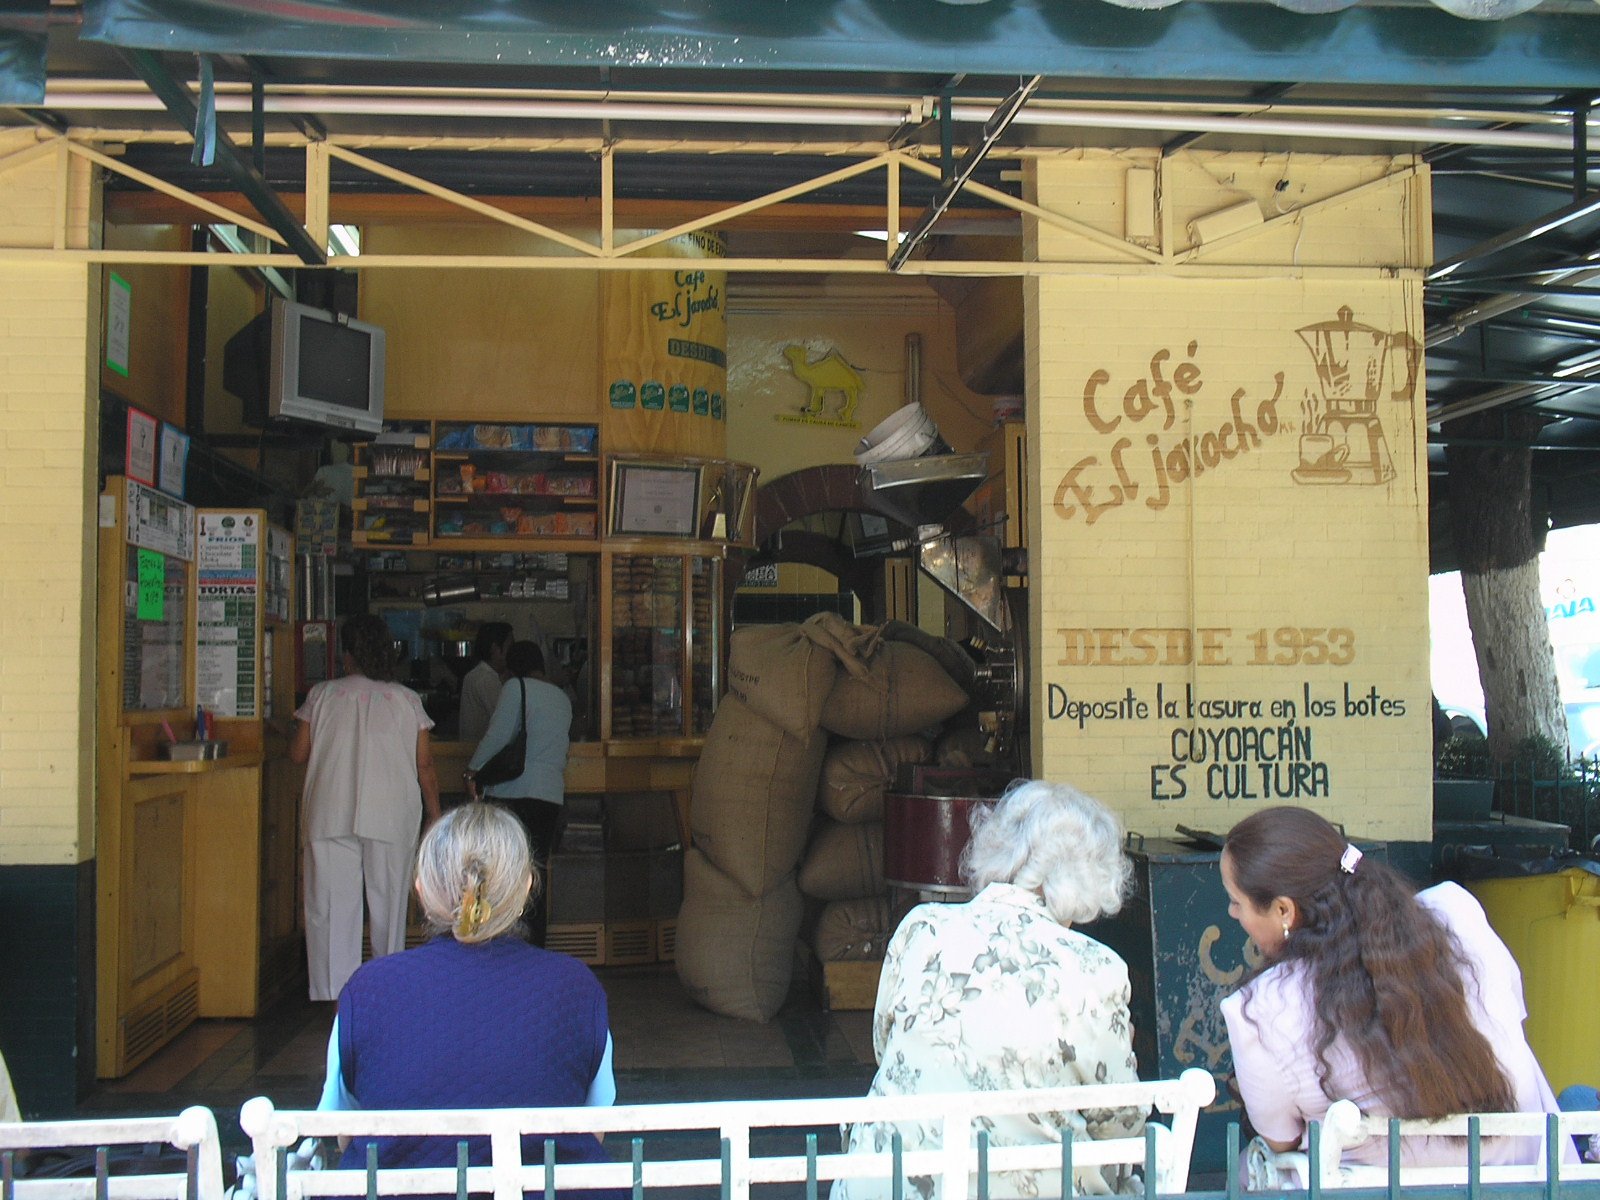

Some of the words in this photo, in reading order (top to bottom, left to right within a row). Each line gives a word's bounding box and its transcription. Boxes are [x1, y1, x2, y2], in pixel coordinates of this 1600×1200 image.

[688, 232, 706, 250] FINO
[651, 292, 681, 321] El
[669, 340, 715, 361] DESDE
[1083, 340, 1204, 434] Café
[1053, 437, 1137, 525] El
[198, 586, 256, 595] TORTAS
[1057, 627, 1232, 667] DESDE
[1246, 627, 1356, 667] 1953
[1048, 684, 1148, 729] Deposite
[1156, 683, 1180, 719] la
[1270, 699, 1296, 720] en
[1304, 682, 1337, 719] los
[1344, 683, 1406, 718] botes
[1151, 764, 1188, 800] ES
[1206, 762, 1330, 800] CULTURA
